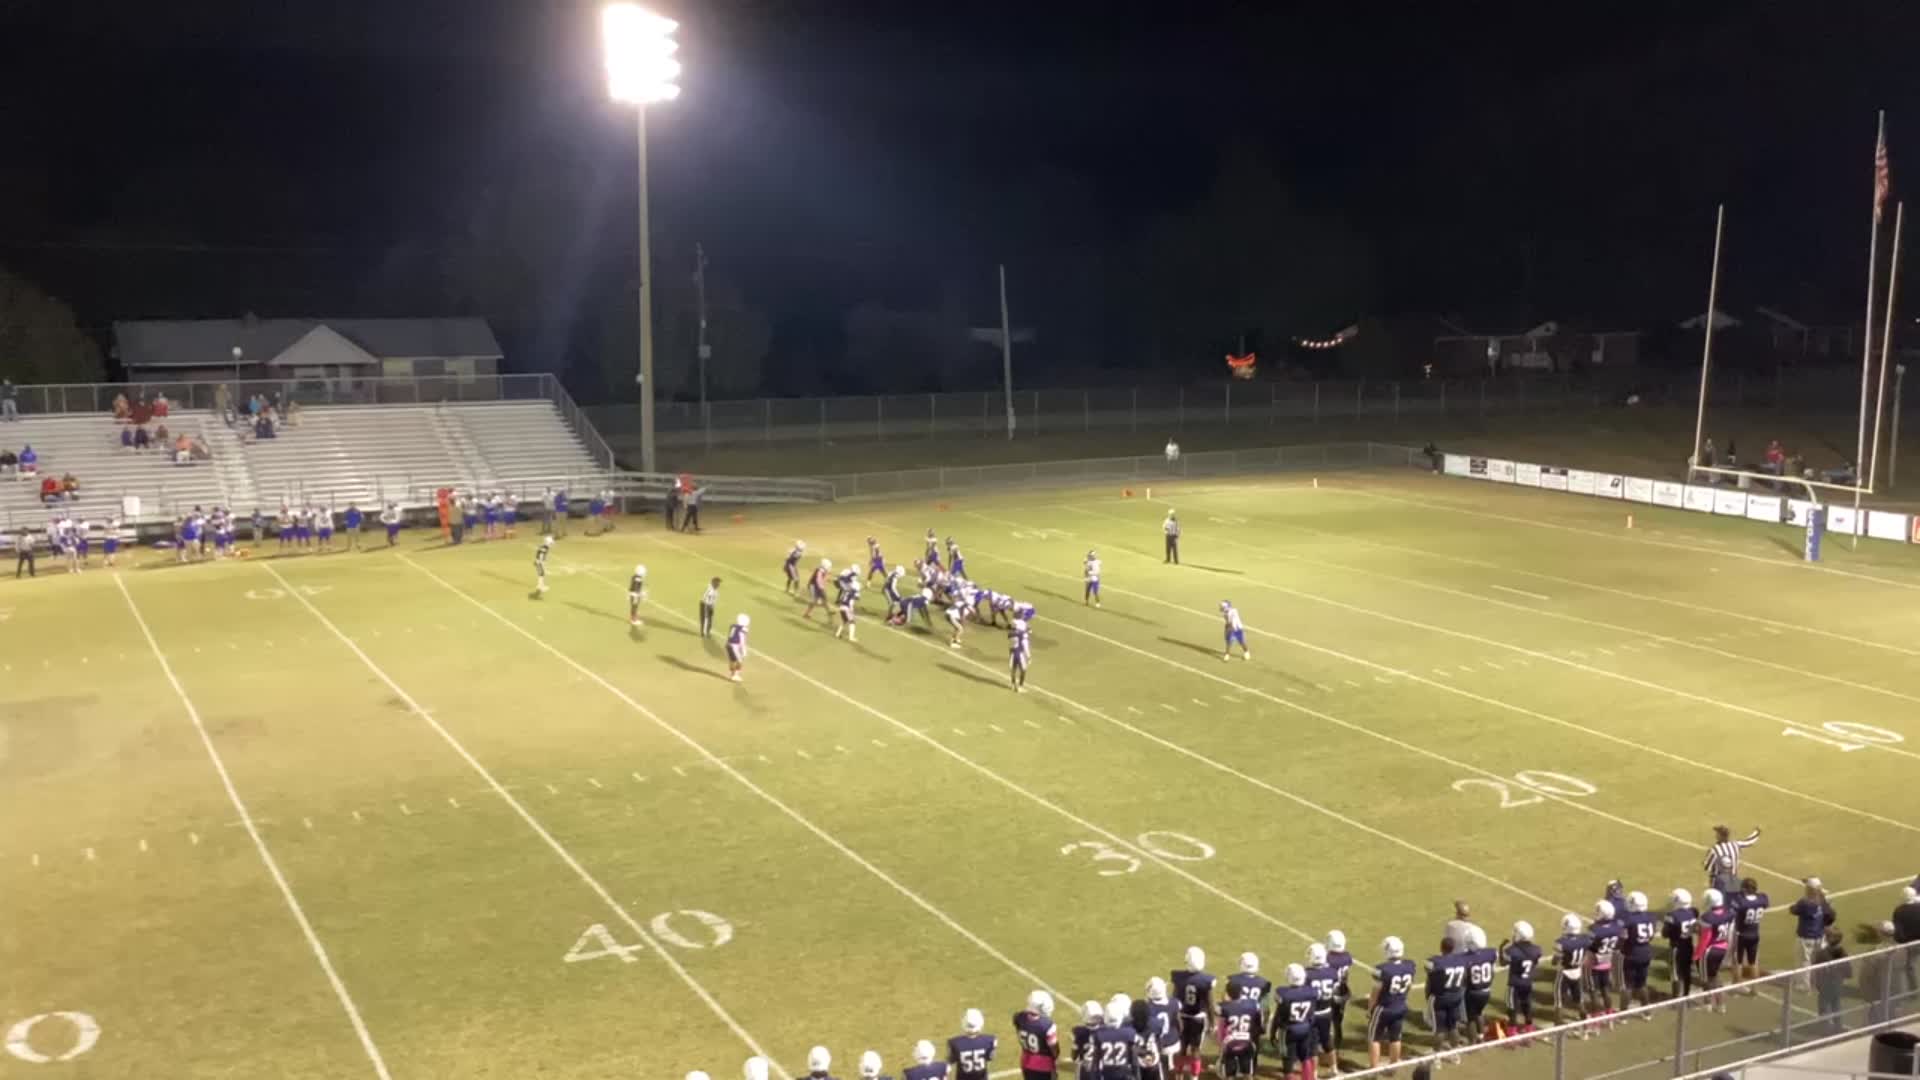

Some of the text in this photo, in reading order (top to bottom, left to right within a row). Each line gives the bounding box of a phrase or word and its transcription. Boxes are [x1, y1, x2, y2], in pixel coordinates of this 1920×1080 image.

[1451, 769, 1597, 809] 20
[1060, 830, 1216, 876] 30
[563, 909, 733, 963] 40
[1445, 966, 1465, 988] 77
[1471, 962, 1492, 984] 60
[1185, 984, 1197, 1005] 6
[1290, 1001, 1311, 1021] 57
[5, 1011, 102, 1063] 0
[1228, 1014, 1251, 1037] 26
[959, 1049, 986, 1072] 55
[1101, 1041, 1127, 1066] 22
